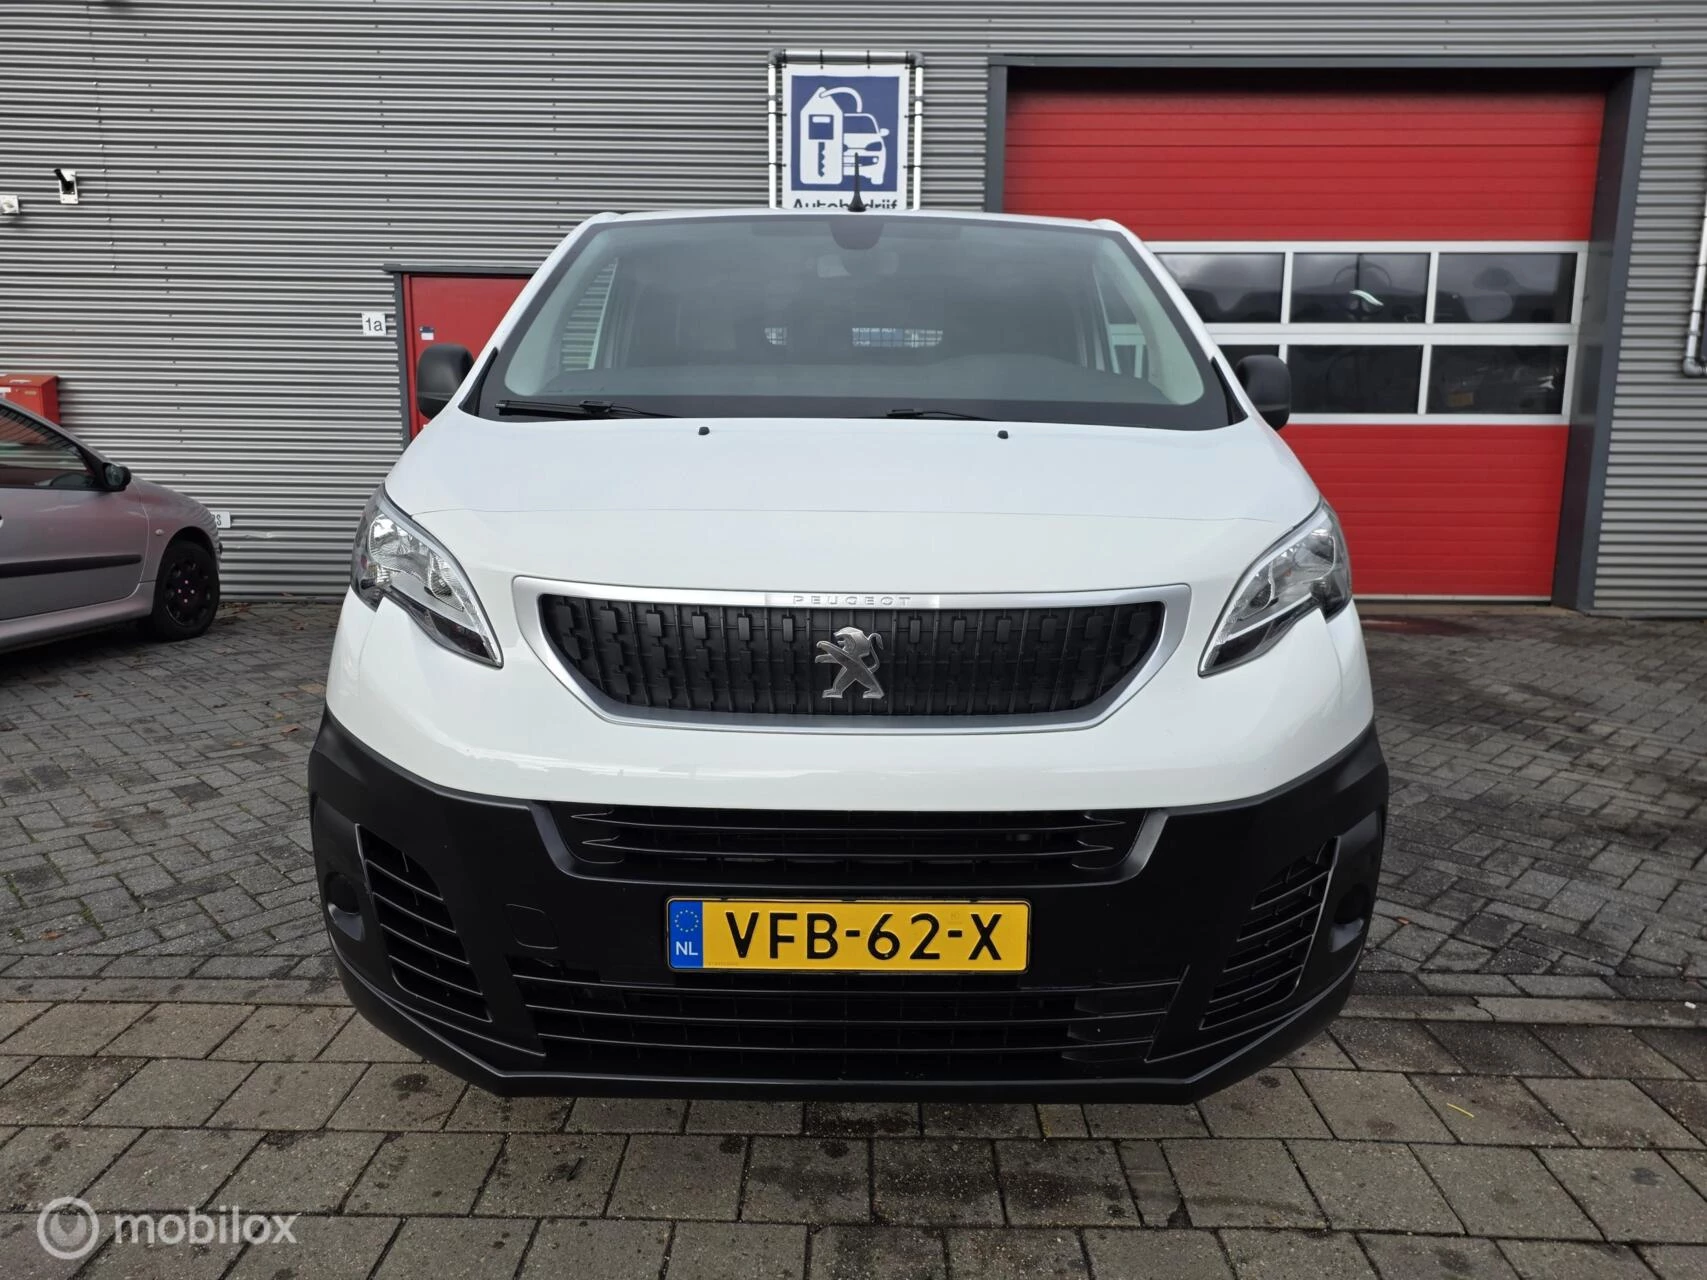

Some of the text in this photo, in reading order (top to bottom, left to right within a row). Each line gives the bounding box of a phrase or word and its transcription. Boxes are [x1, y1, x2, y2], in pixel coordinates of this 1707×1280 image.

[365, 318, 384, 332] 1a
[793, 595, 911, 606] PEUGEOT
[725, 911, 1002, 961] VFB-62-X
[675, 941, 699, 956] NL
